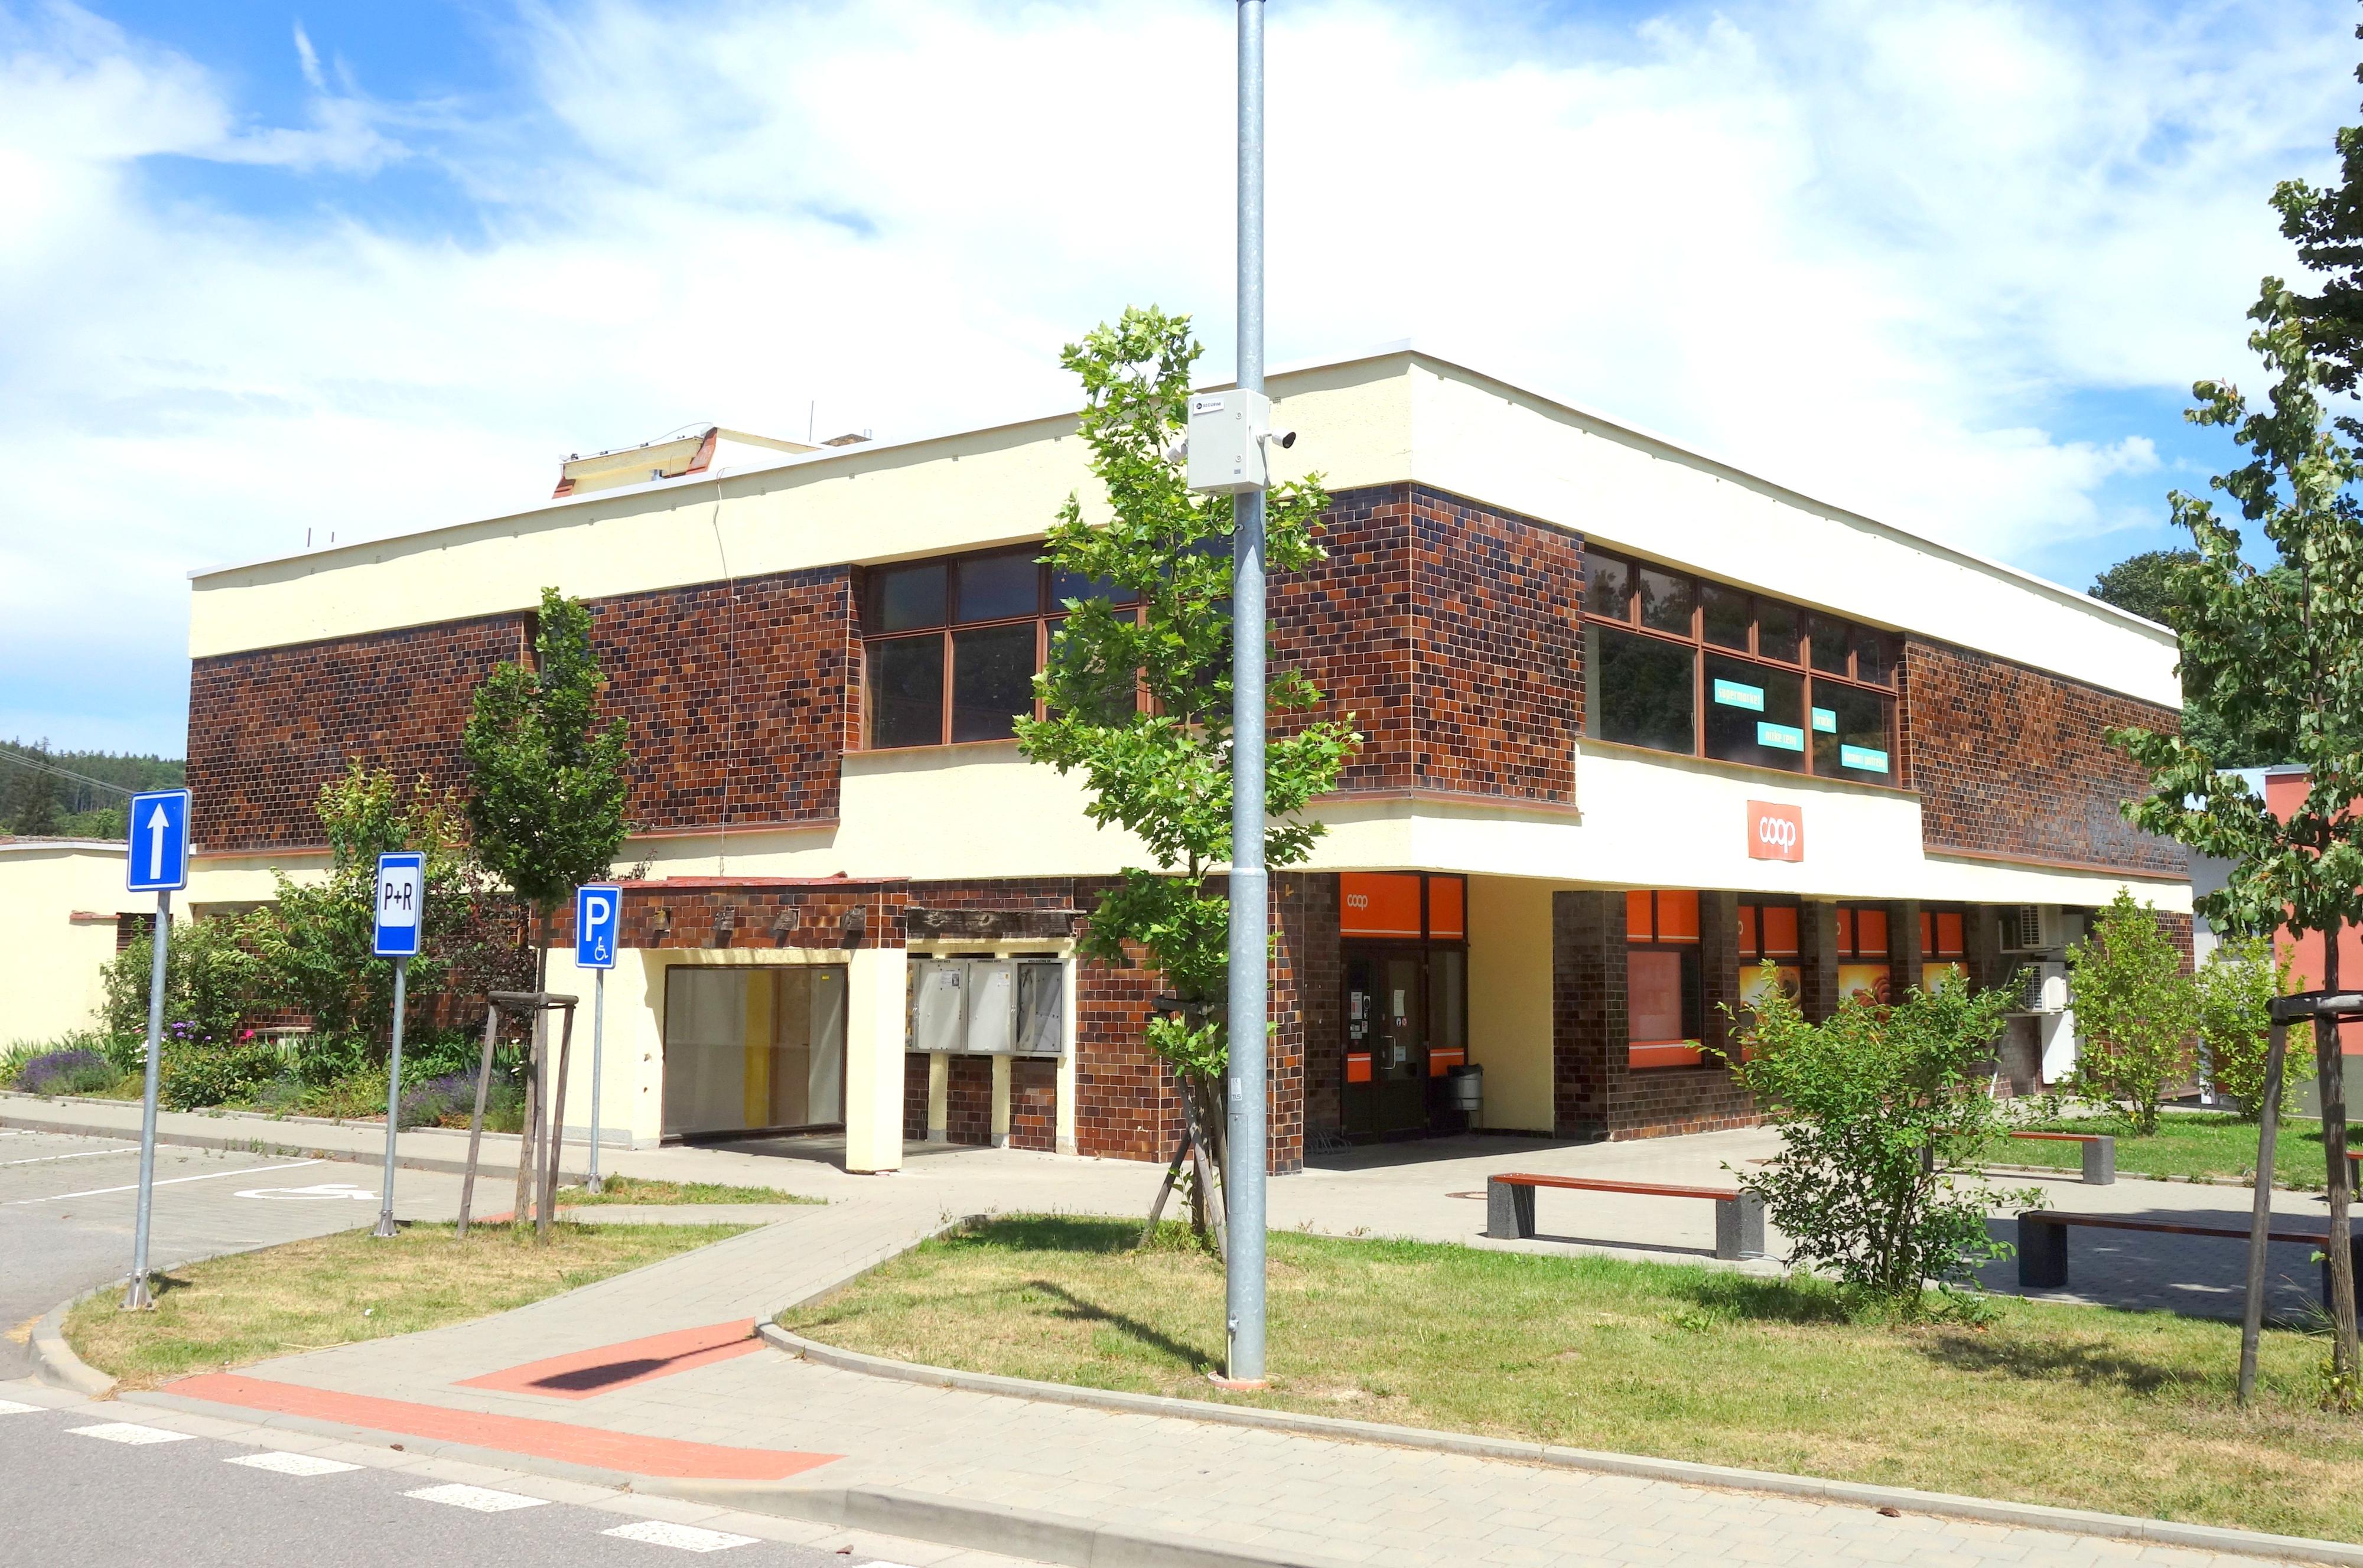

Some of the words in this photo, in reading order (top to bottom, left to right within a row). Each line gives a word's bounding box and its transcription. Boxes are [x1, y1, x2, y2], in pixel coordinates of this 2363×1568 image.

[1718, 688, 1760, 705] supermarket
[1759, 816, 1796, 853] coop
[384, 882, 412, 910] P+R
[1347, 894, 1368, 911] coop
[585, 897, 610, 941] P
